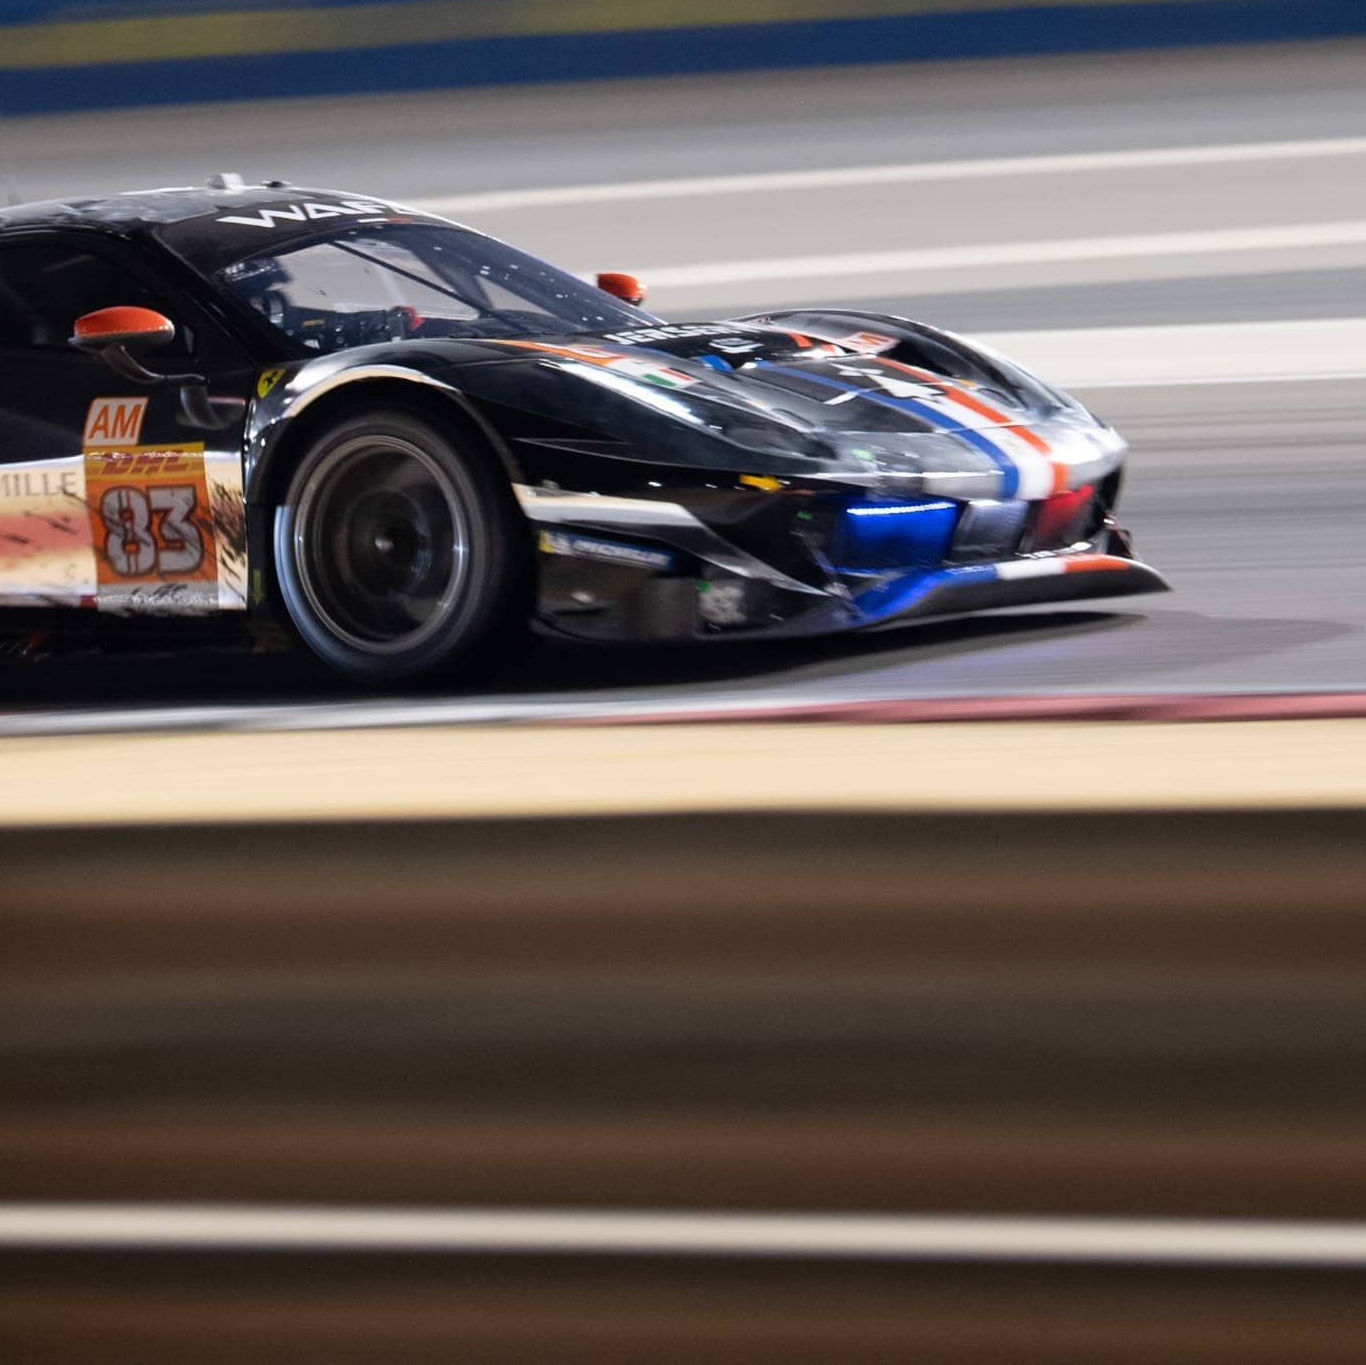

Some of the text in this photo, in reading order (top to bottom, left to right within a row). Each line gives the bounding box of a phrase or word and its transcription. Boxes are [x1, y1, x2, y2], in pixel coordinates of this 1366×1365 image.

[89, 404, 143, 440] AM
[101, 450, 190, 475] DHL
[100, 486, 205, 578] 83
